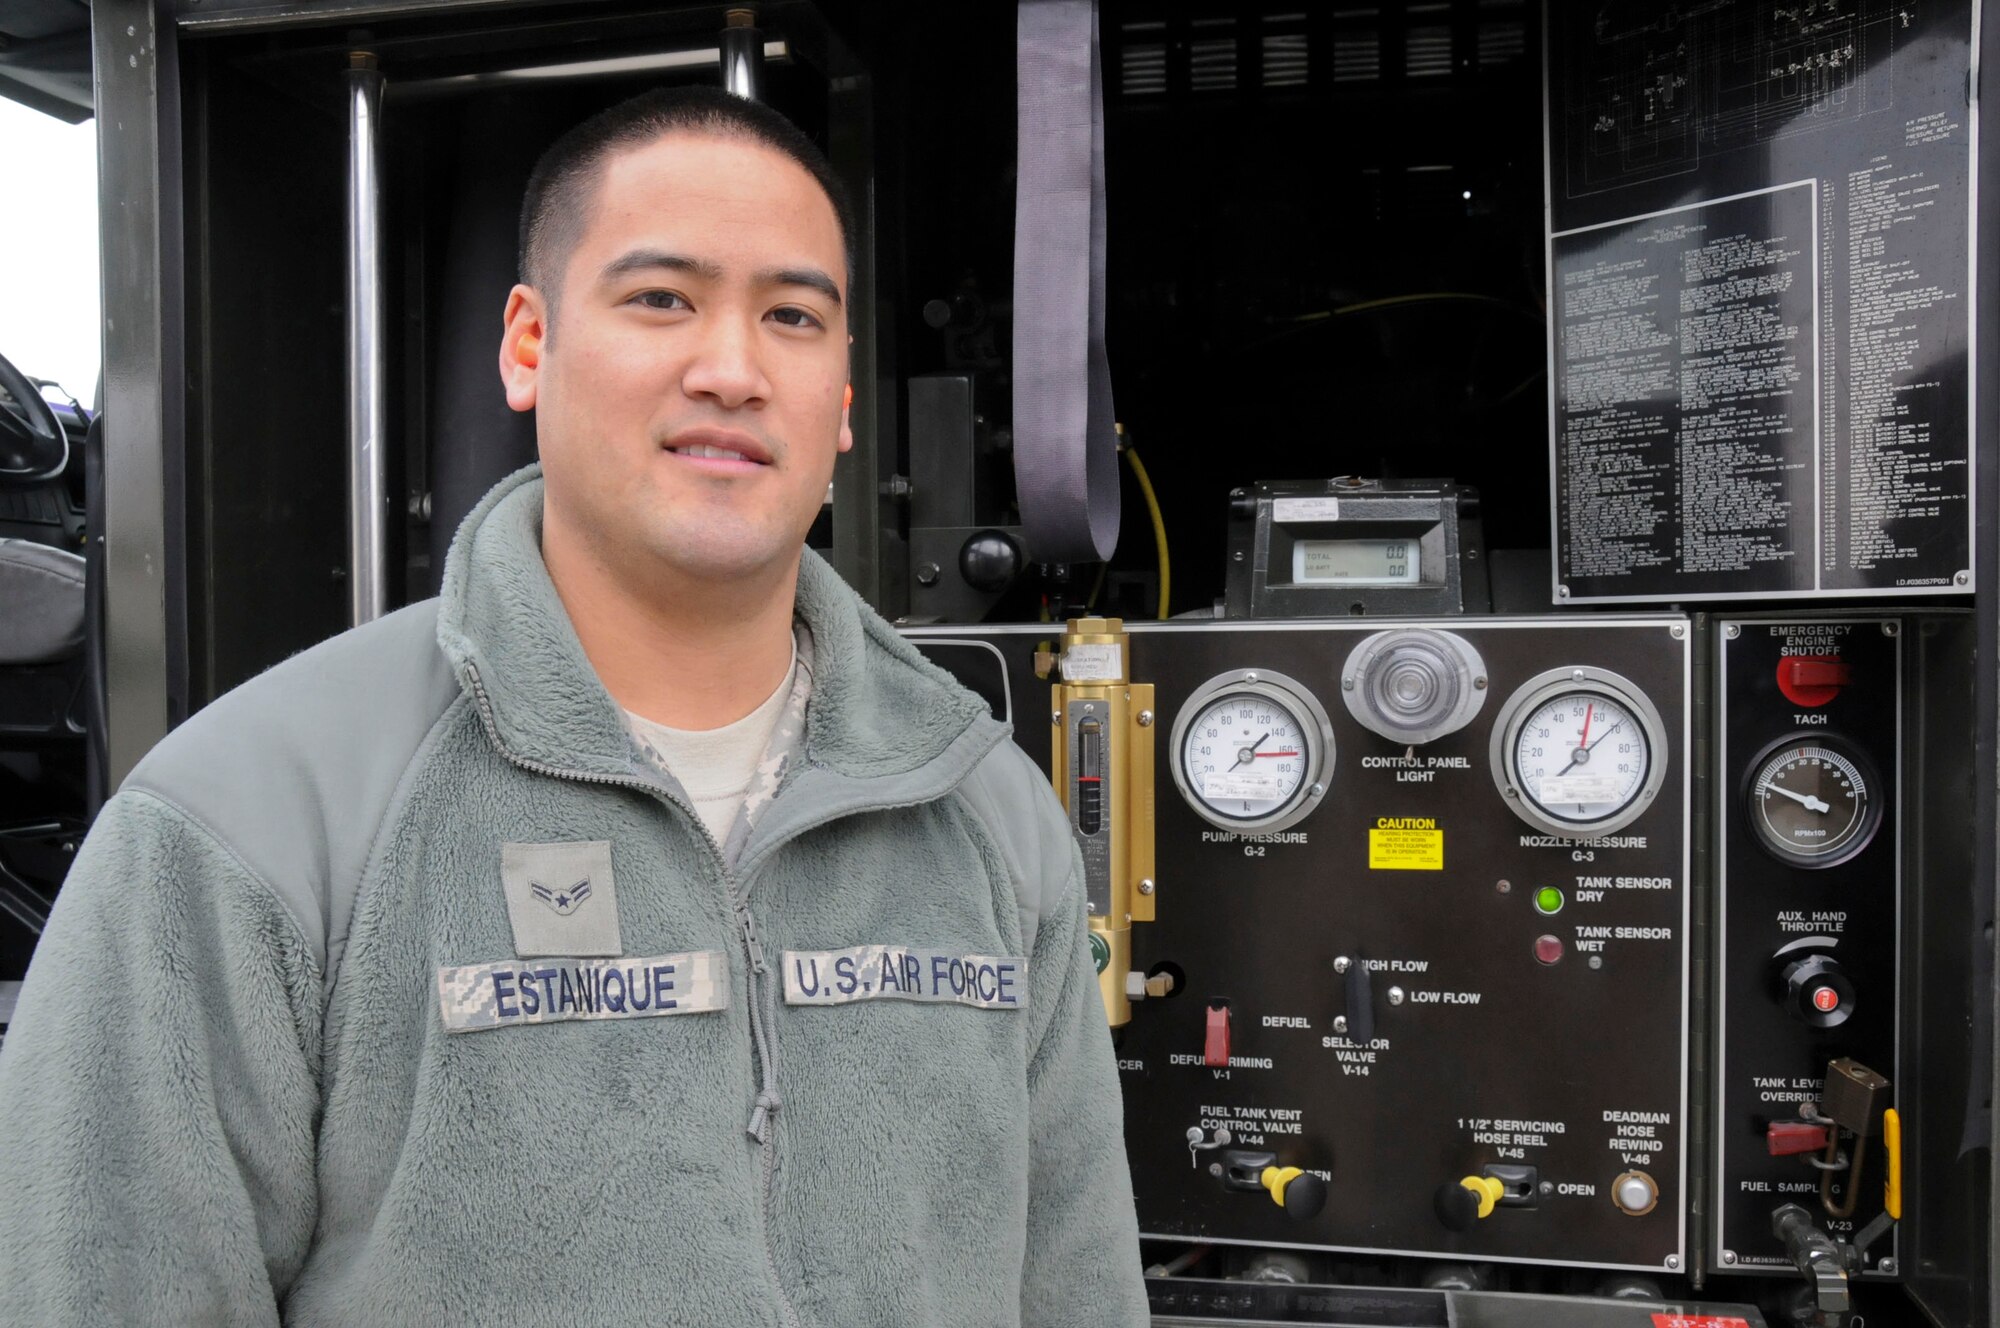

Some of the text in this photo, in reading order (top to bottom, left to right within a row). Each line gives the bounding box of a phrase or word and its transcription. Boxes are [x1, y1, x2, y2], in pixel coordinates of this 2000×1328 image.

[1770, 626, 1851, 637] EMERGENCY
[1786, 636, 1835, 646] ENGINE
[1781, 646, 1840, 656] SHUTOFF
[1240, 710, 1253, 719] 100
[1573, 707, 1584, 717] 50
[1594, 713, 1605, 722] 60
[1221, 716, 1232, 725] 80
[1257, 715, 1271, 724] 120
[1553, 714, 1564, 723] 40
[1794, 714, 1827, 724] TACH
[1207, 729, 1217, 738] 60
[1272, 728, 1285, 737] 140
[1539, 729, 1549, 738] 30
[1200, 747, 1211, 756] 40
[1532, 748, 1543, 757] 20
[1619, 744, 1630, 753] 80
[1362, 757, 1470, 768] CONTROL PANEL
[1277, 764, 1291, 773] 180
[1536, 768, 1544, 777] 10
[1618, 764, 1629, 773] 90
[1396, 772, 1435, 782] LIGHT
[1378, 818, 1435, 829] CAUTION
[1202, 832, 1308, 843] PUMP PRESSURE
[1520, 836, 1647, 848] NOZZLE PRESSURE
[1244, 847, 1265, 856] G-2
[1572, 851, 1594, 861] G-3
[1576, 877, 1672, 889] TANK SENSOR
[1576, 891, 1604, 902] DRY
[1777, 911, 1847, 921] AUX. HAND
[1780, 922, 1844, 932] THROTTLE
[1576, 927, 1671, 939] TANK SENSOR
[1576, 941, 1605, 951] WET
[1391, 961, 1428, 972] FLOW
[796, 952, 1016, 1005] U.S. AIR FORCE
[491, 965, 678, 1018] ESTANIQUE
[1411, 992, 1481, 1004] LOW FLOW
[1262, 1016, 1311, 1028] DEFUEL
[1322, 1037, 1389, 1050] SELEOR
[1170, 1054, 1273, 1069] DEFU RIMING
[1336, 1051, 1376, 1062] VALVE
[1118, 1060, 1143, 1071] CER
[1343, 1065, 1369, 1076] V-14
[1213, 1070, 1230, 1080] V-1
[1753, 1078, 1824, 1088] TANK LEVE
[1761, 1091, 1822, 1102] OVERRIDE
[1200, 1106, 1302, 1120] FUEL TANK VENT
[1603, 1111, 1670, 1124] DEADMAN
[1201, 1119, 1302, 1134] CONTROL VALVE
[1458, 1119, 1464, 1128] 1
[1494, 1120, 1565, 1134] SERVICING
[1617, 1126, 1655, 1137] HOSE
[1238, 1134, 1264, 1145] V-44
[1474, 1133, 1547, 1146] HOSE REEL
[1609, 1139, 1663, 1151] REWIND
[1497, 1147, 1524, 1159] V-45
[1622, 1153, 1650, 1165] V-46
[1558, 1184, 1595, 1195] OPEN
[1741, 1182, 1840, 1194] FUEL SAMPLG
[1827, 1221, 1853, 1230] V-23
